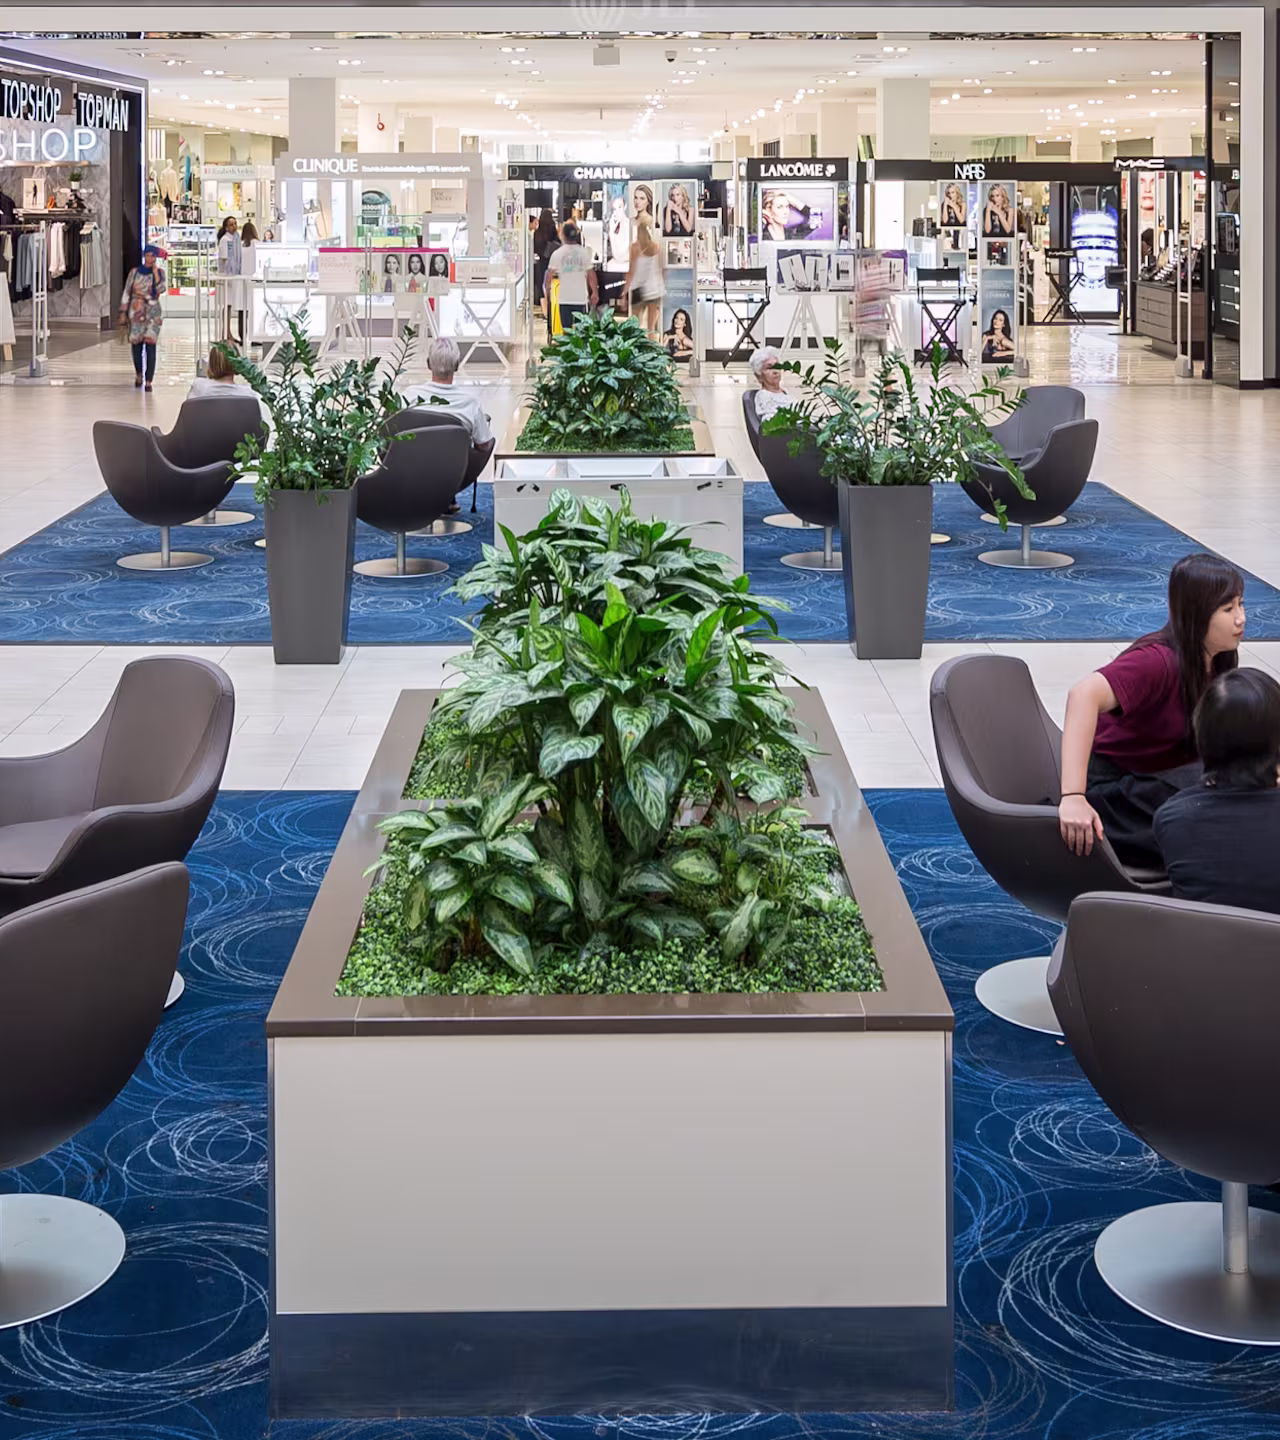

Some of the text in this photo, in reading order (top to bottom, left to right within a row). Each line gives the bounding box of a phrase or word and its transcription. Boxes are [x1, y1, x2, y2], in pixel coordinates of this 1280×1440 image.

[1, 78, 130, 132] TOPSHOP TOPMAN
[293, 158, 359, 175] CLINIQUE
[760, 161, 823, 178] LANCÔME
[955, 163, 986, 180] NARS
[1115, 158, 1165, 169] MAC
[573, 166, 631, 180] CHANEL
